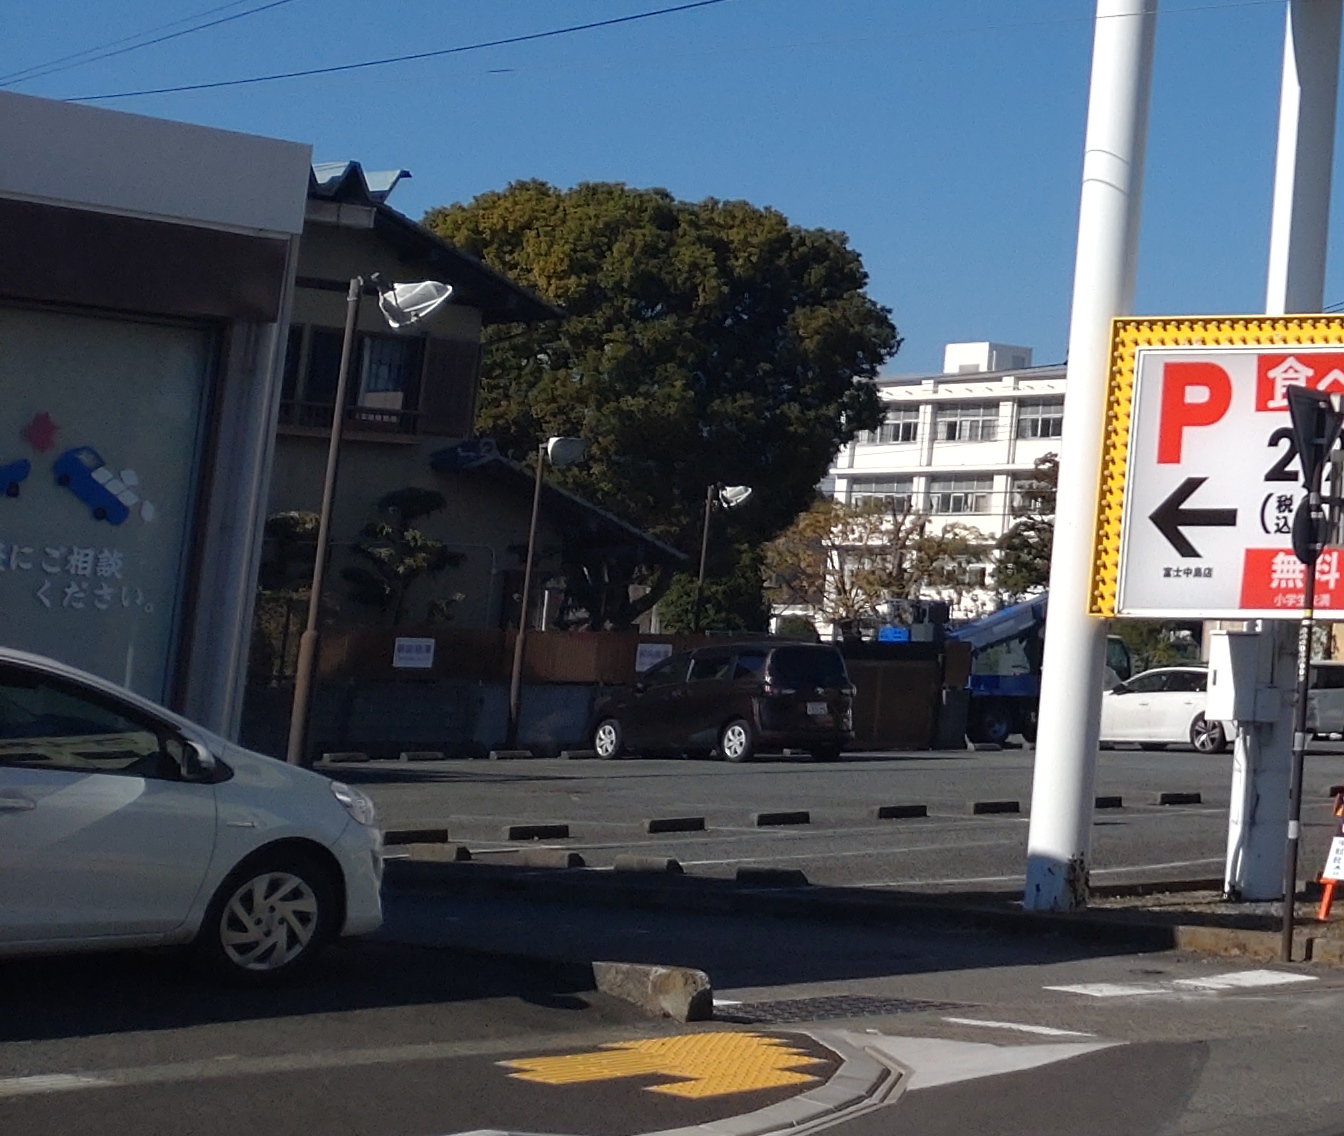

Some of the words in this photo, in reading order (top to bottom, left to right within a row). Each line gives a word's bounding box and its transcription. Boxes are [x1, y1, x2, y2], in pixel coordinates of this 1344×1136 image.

[1156, 361, 1233, 465] P
[0, 544, 124, 579] にご相談
[1162, 566, 1213, 578] 富士中島店
[1269, 552, 1340, 590] 無料
